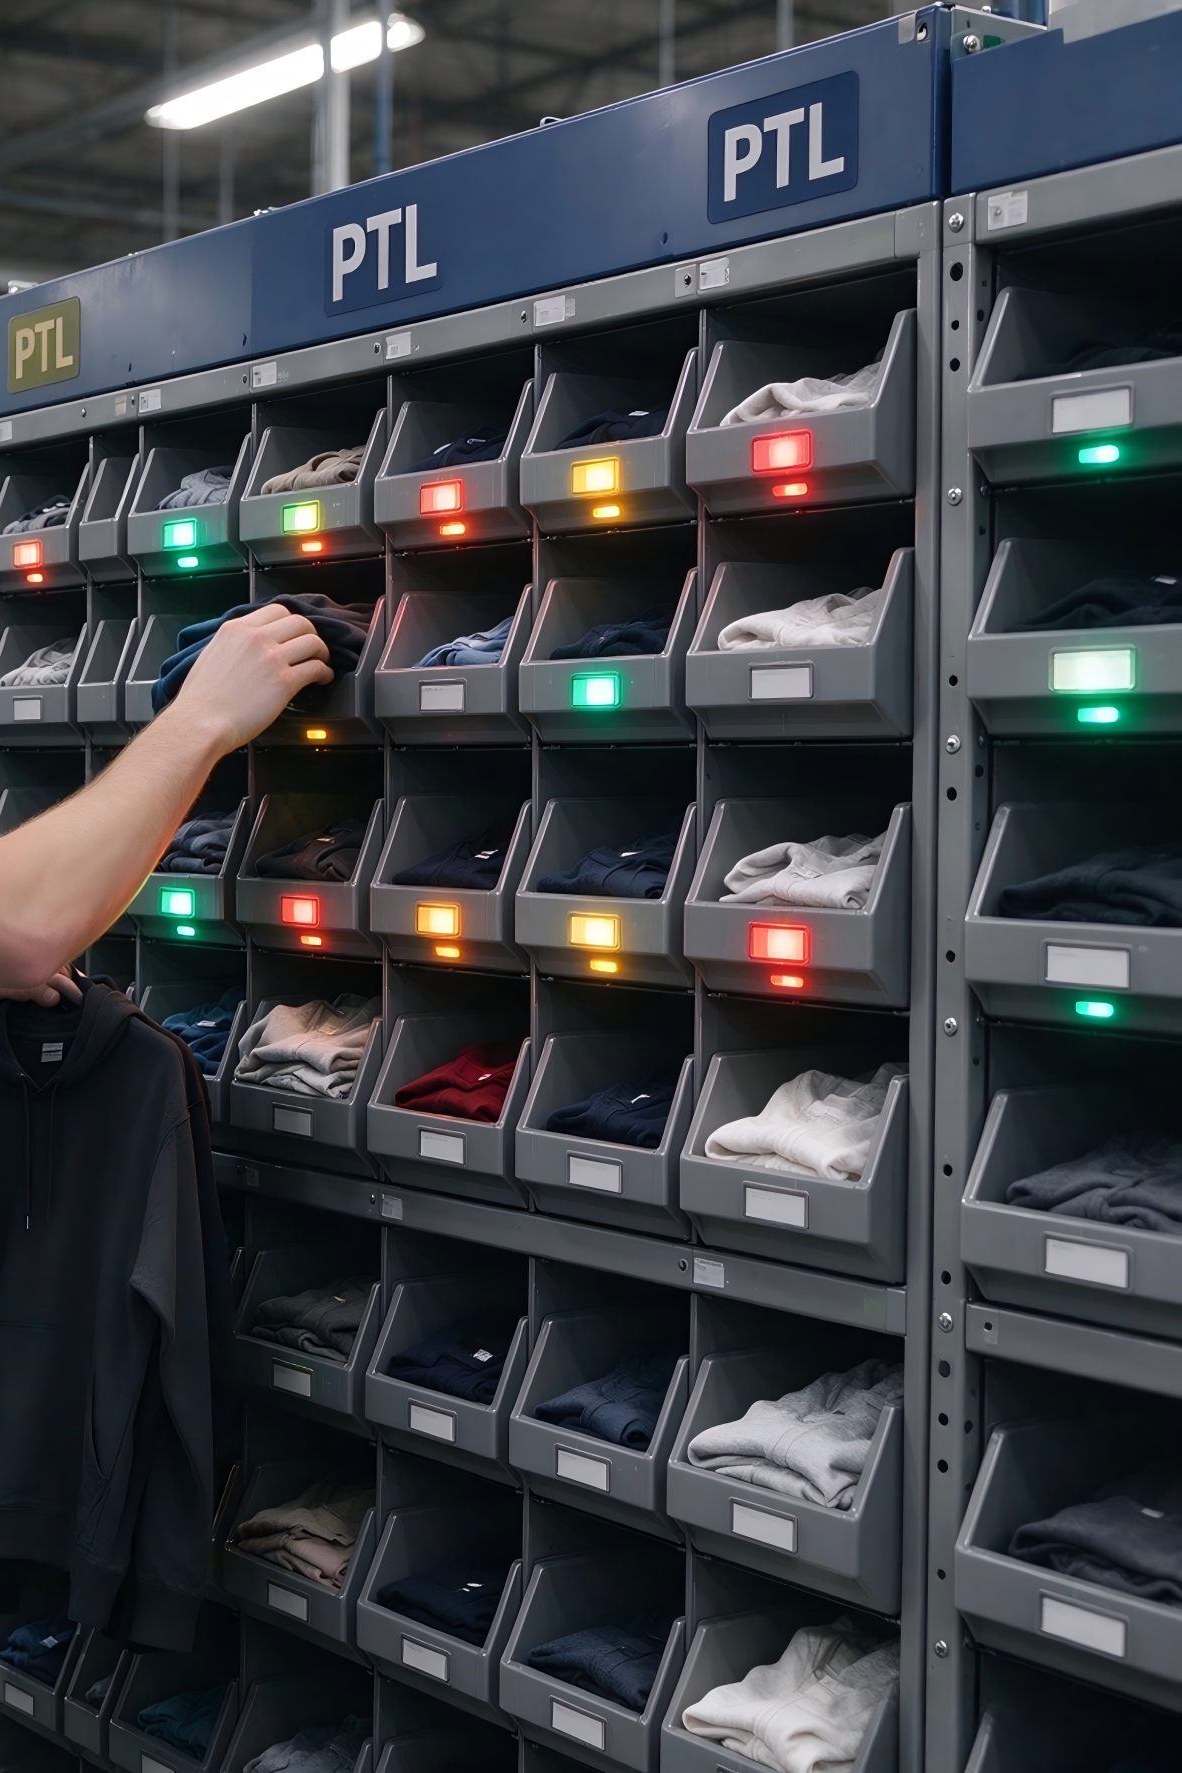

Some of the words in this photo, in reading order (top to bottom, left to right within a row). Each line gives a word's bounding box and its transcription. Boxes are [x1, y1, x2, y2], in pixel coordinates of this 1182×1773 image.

[723, 102, 845, 203] PTL
[332, 203, 437, 302] PTL
[14, 315, 74, 379] PTL
